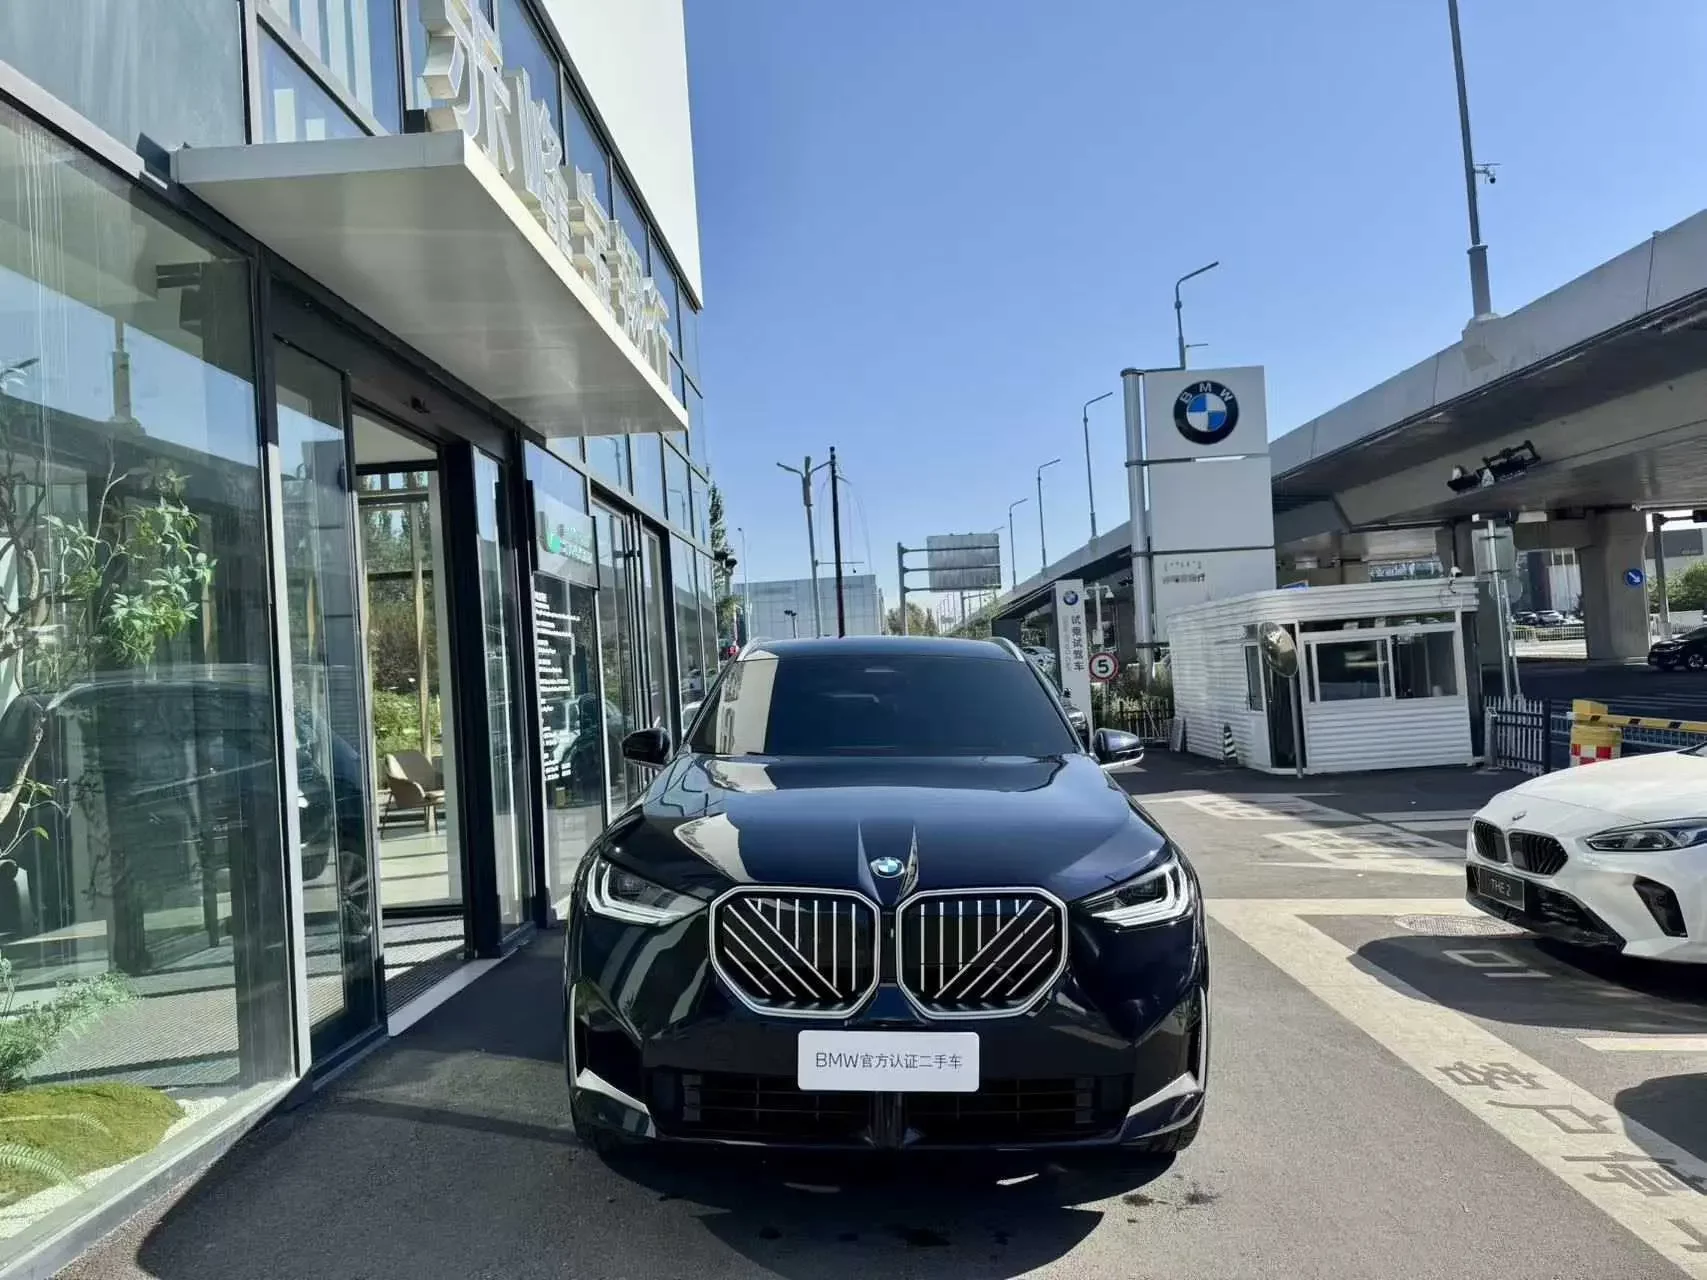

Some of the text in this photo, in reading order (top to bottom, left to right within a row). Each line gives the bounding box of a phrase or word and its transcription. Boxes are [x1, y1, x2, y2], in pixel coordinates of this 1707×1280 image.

[1180, 382, 1234, 404] BMW
[1097, 660, 1110, 674] 5
[815, 1052, 963, 1070] BMW官方认证二手车
